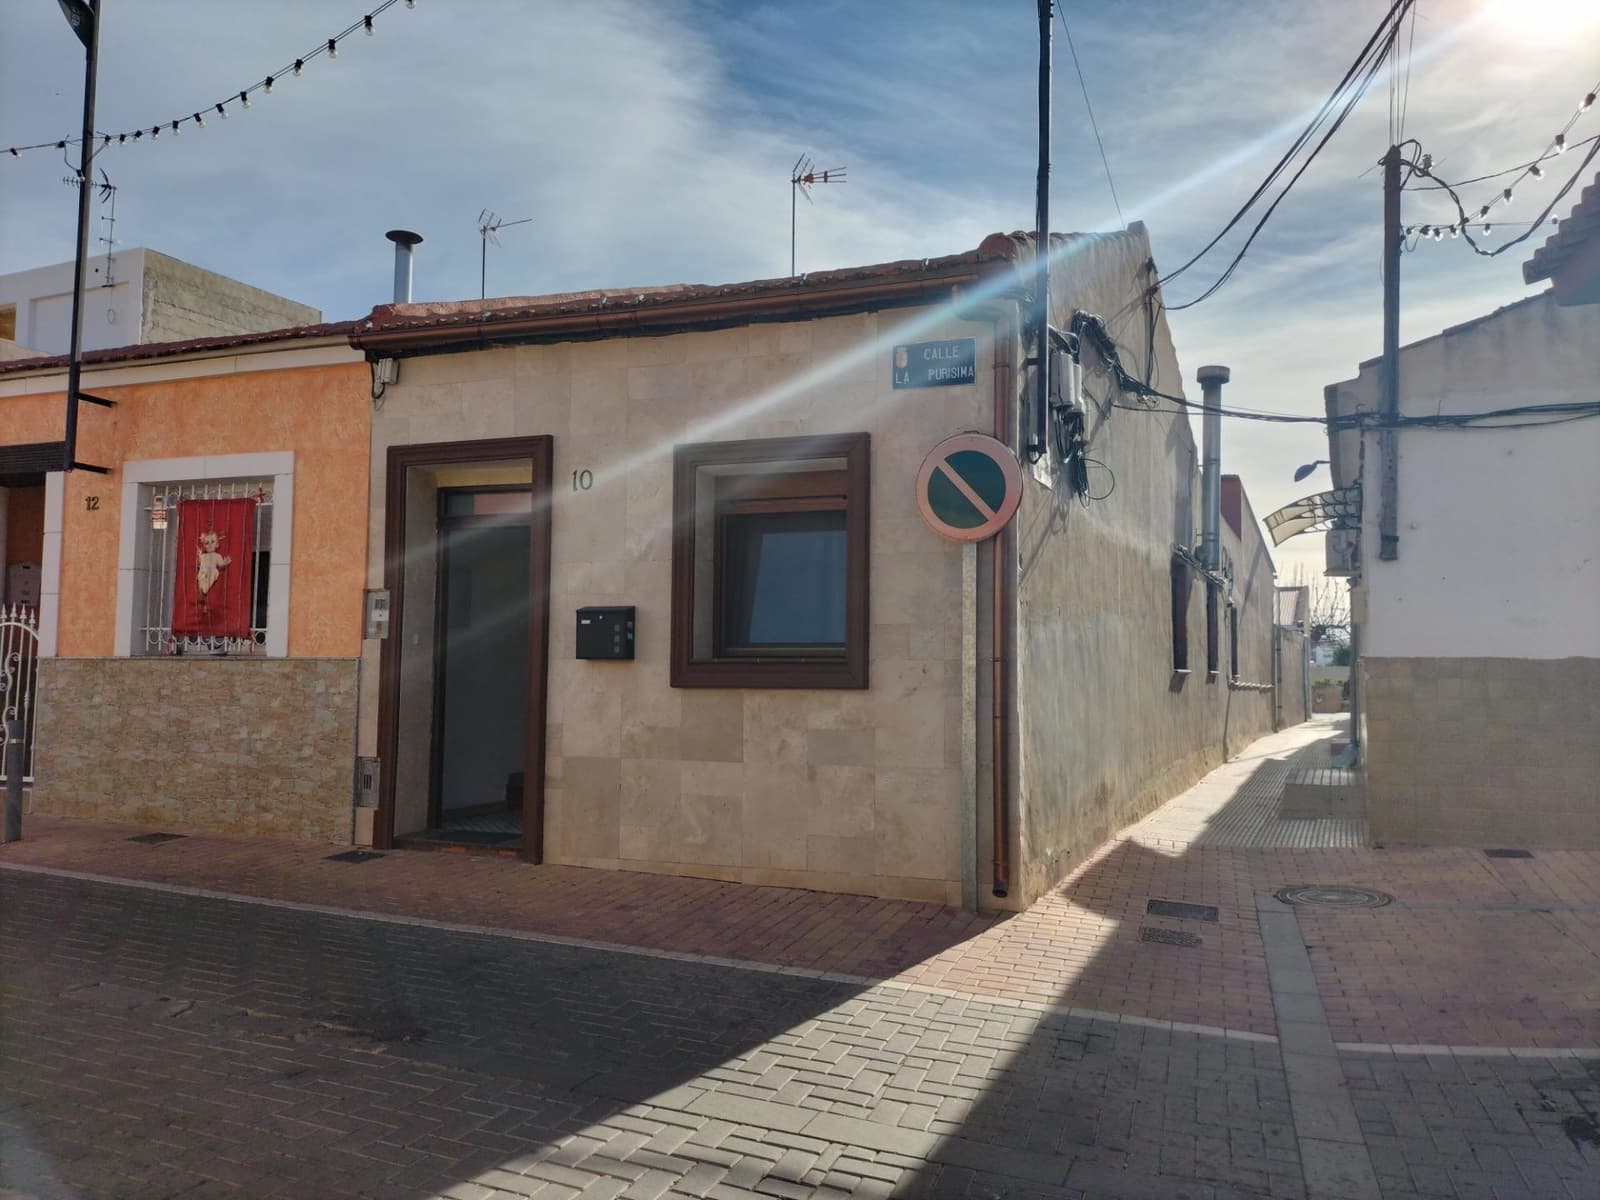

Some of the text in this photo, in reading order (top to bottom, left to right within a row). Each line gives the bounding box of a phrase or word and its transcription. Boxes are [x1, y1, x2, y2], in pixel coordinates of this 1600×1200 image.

[923, 345, 960, 360] CALLE
[895, 366, 974, 384] LA PURISIMA
[572, 469, 593, 492] 10
[85, 496, 100, 511] 12
